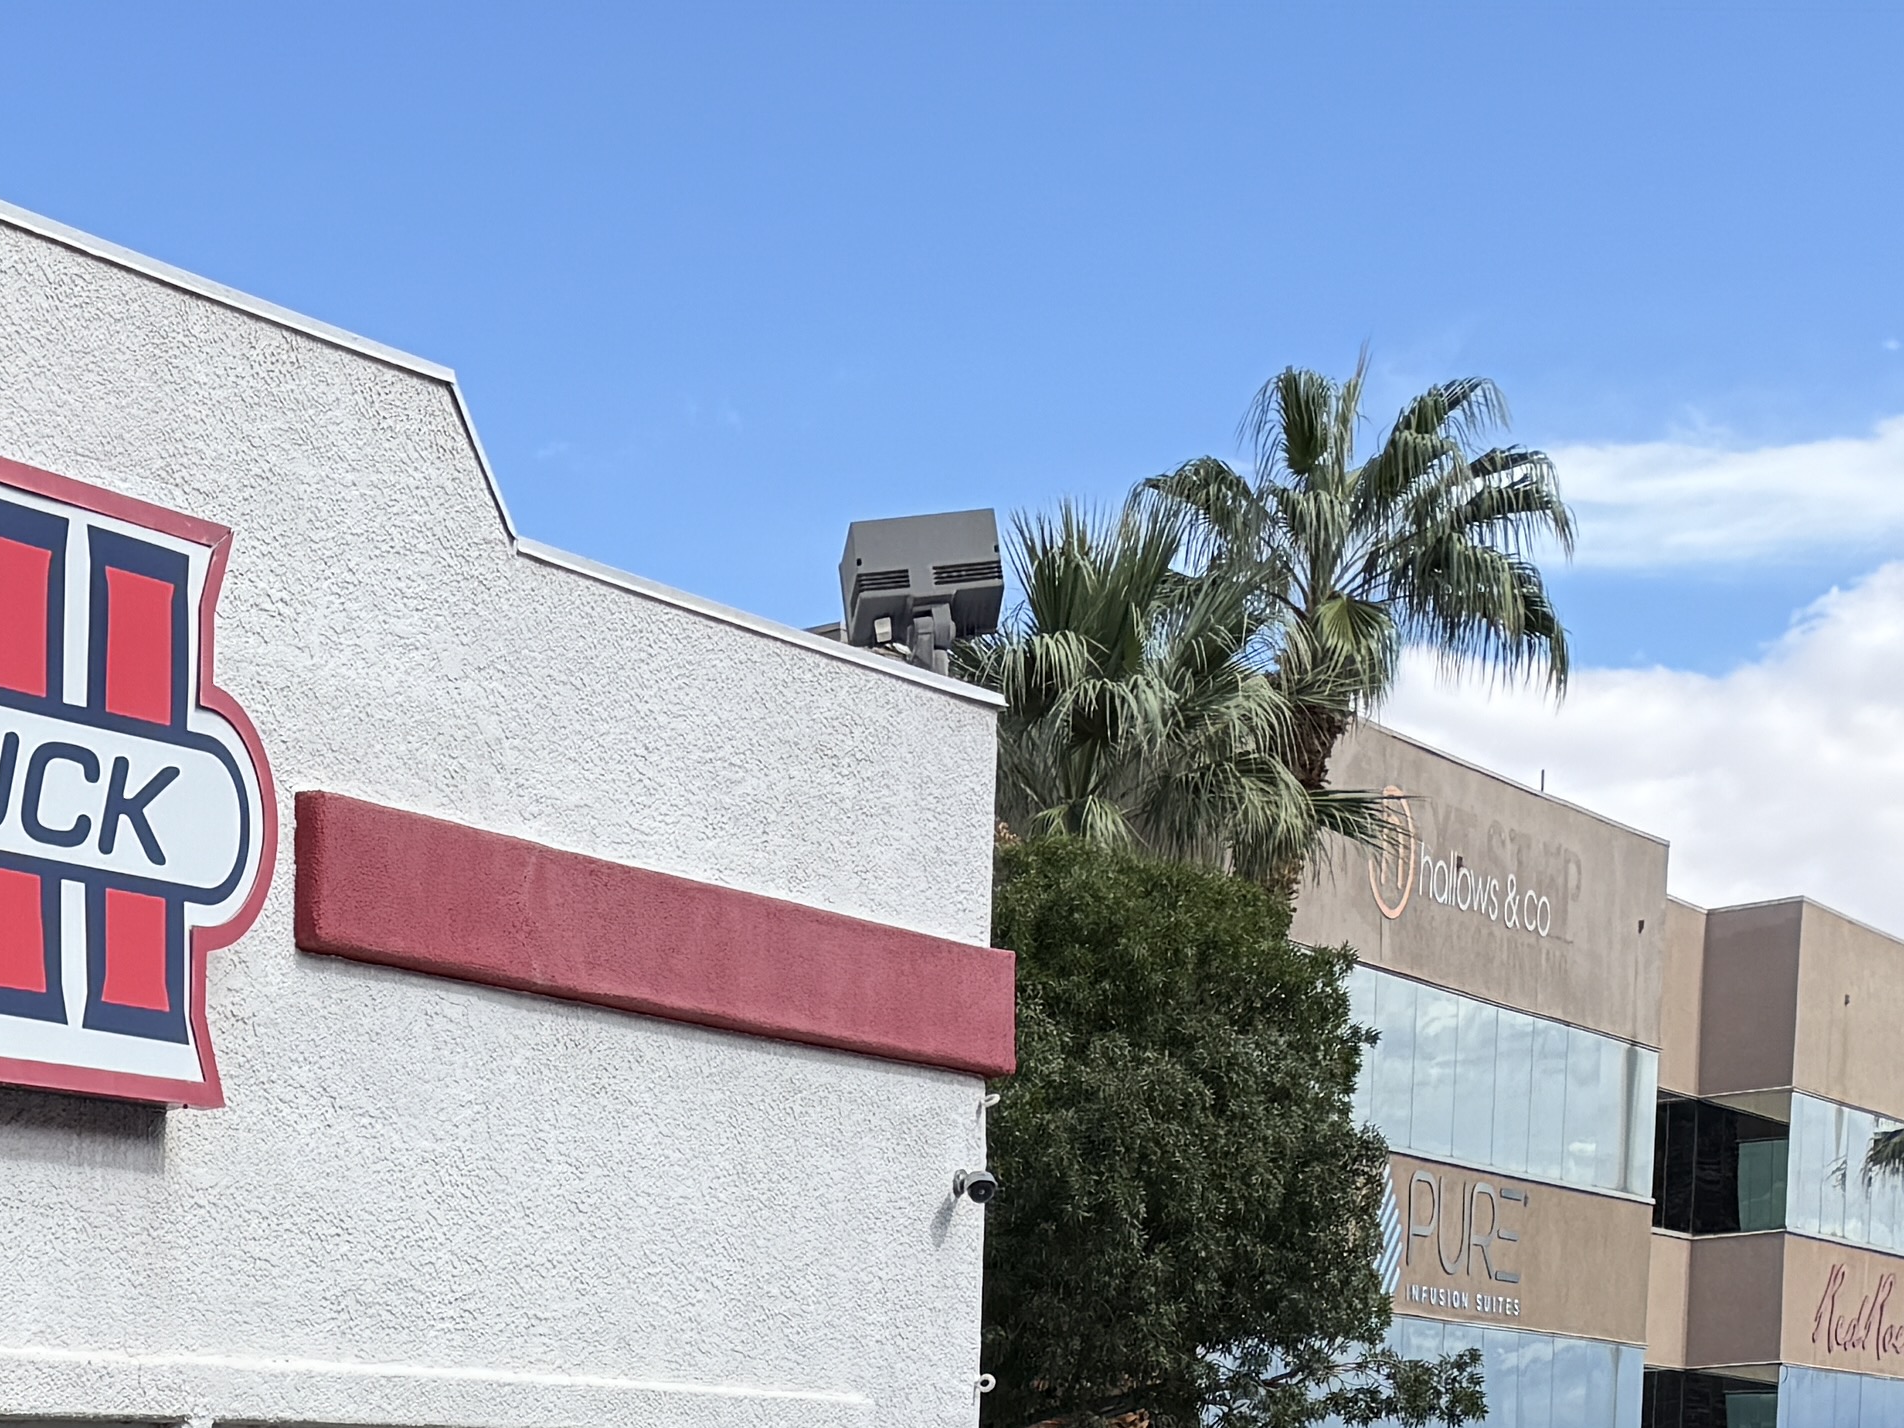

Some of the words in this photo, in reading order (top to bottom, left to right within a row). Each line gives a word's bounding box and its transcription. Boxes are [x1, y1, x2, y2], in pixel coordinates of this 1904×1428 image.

[1418, 841, 1500, 921] hallows
[1504, 873, 1520, 929] &
[1523, 889, 1551, 936] co
[1406, 1169, 1524, 1284] PURE
[1405, 1284, 1469, 1310] INFUSION
[1476, 1293, 1521, 1317] SUITES
